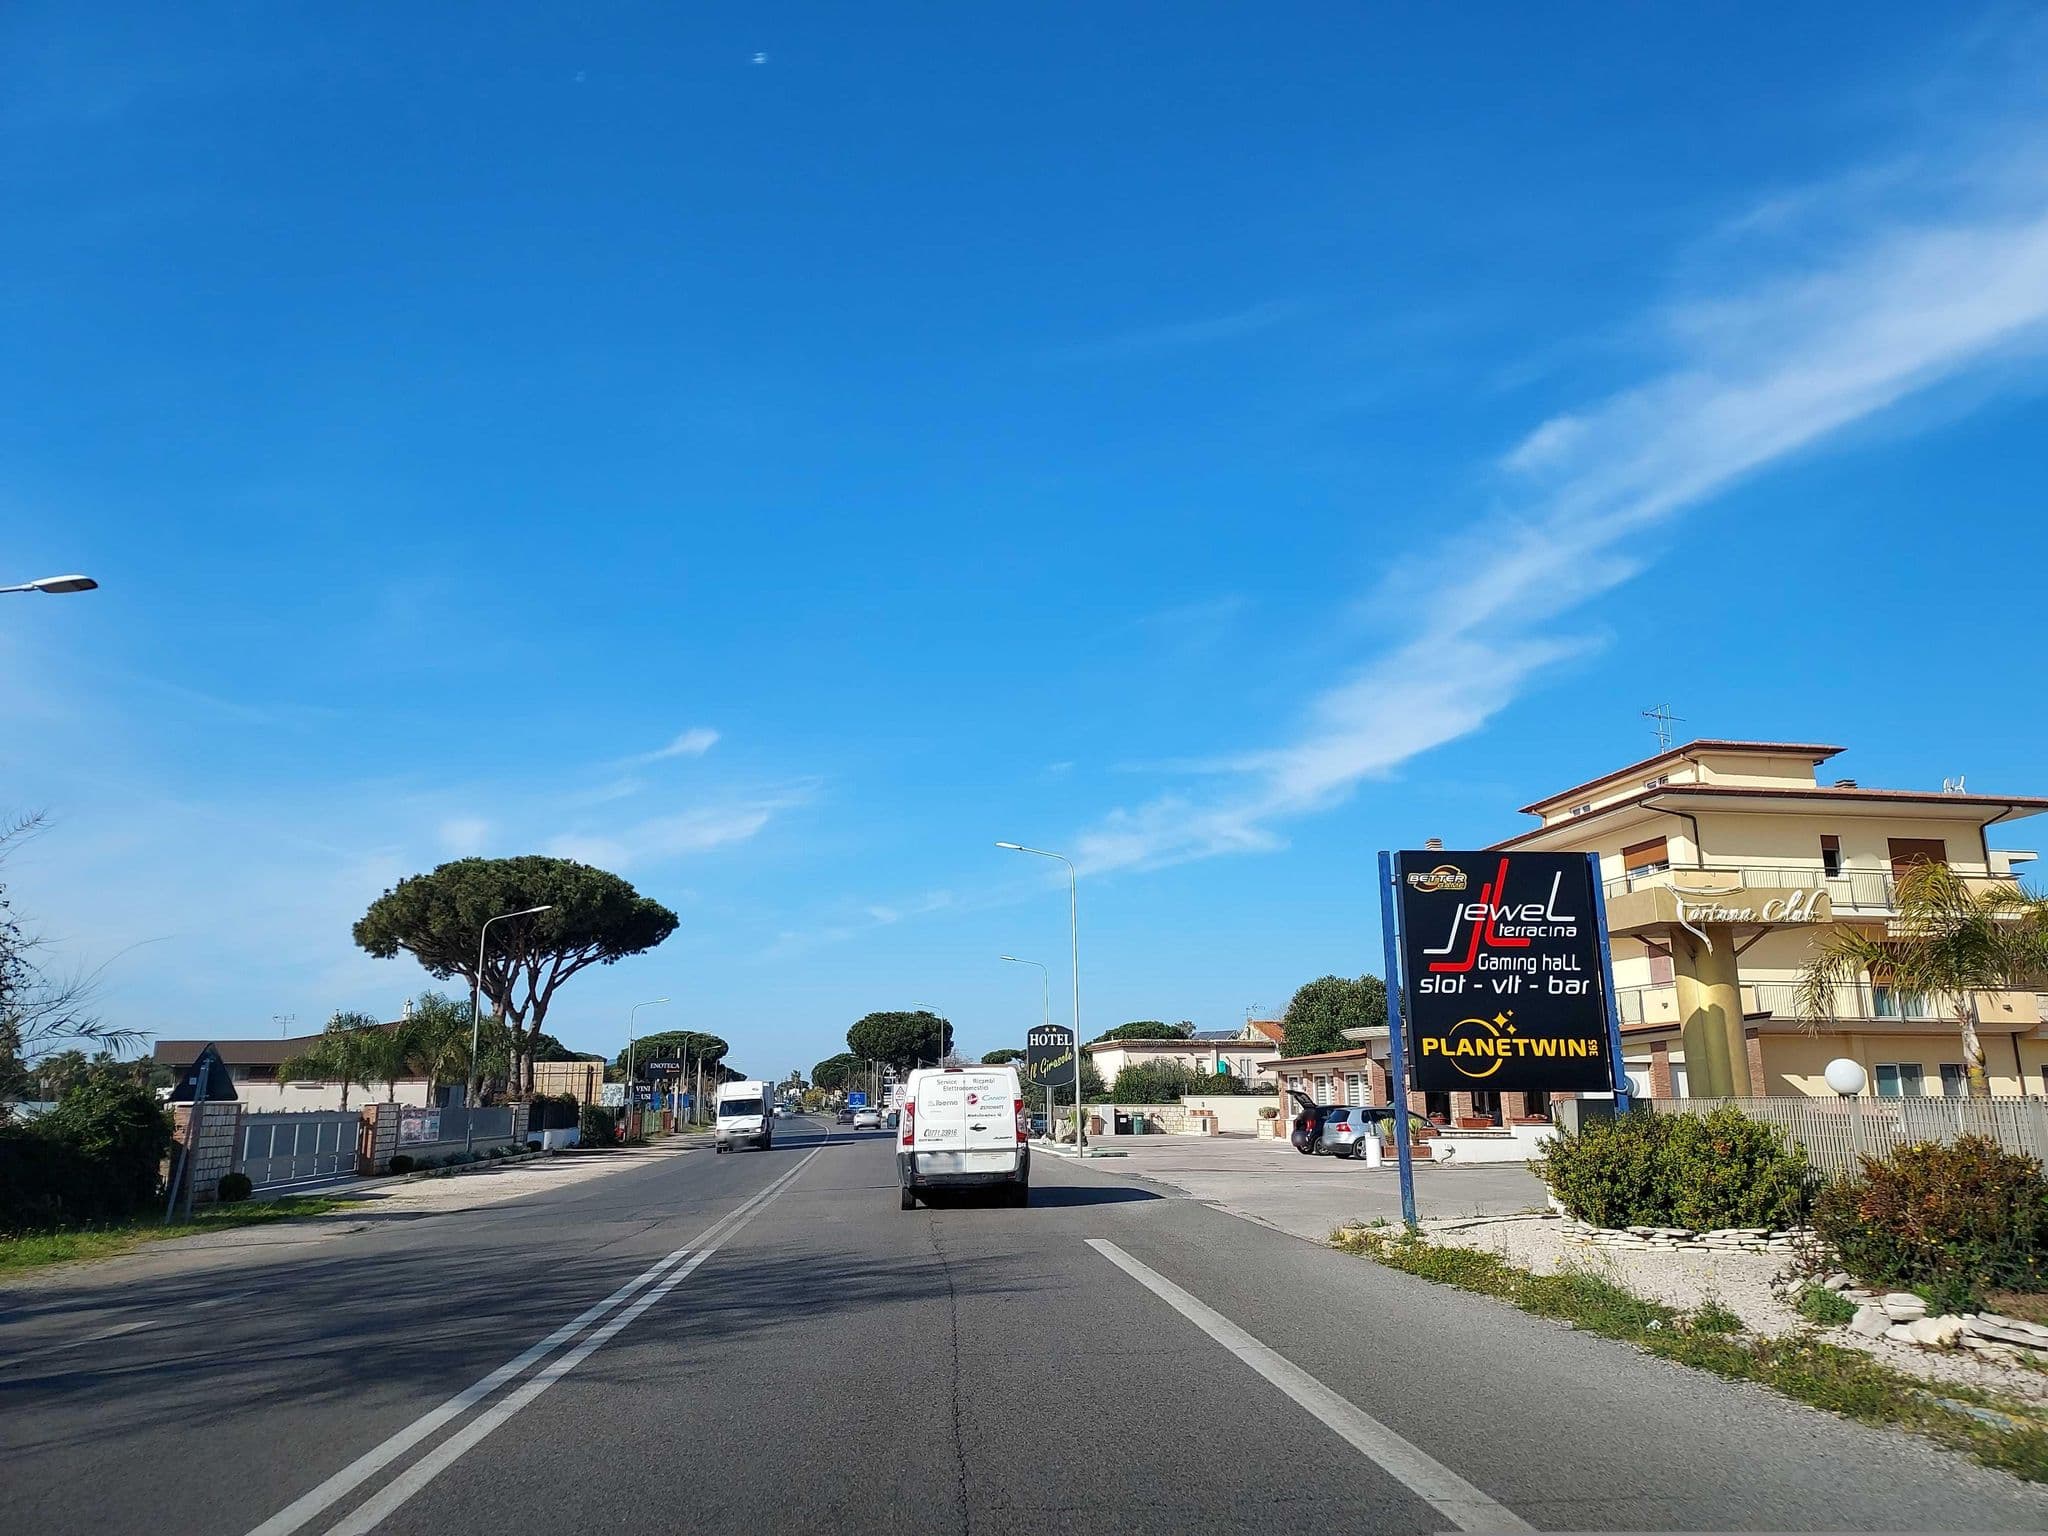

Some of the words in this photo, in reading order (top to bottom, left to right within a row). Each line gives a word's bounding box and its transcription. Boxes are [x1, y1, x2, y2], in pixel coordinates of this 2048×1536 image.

[1409, 874, 1465, 882] BETTER
[1499, 923, 1577, 937] terracina
[1478, 953, 1537, 975] Gaming
[1419, 974, 1466, 994] slot
[1492, 974, 1522, 994] vlt
[1548, 975, 1590, 995] bar
[1029, 1033, 1073, 1046] HOTEL
[1422, 1037, 1588, 1057] PLANETWIN
[1588, 1039, 1599, 1057] 365
[1030, 1062, 1038, 1080] Il
[1040, 1046, 1073, 1078] Girasole
